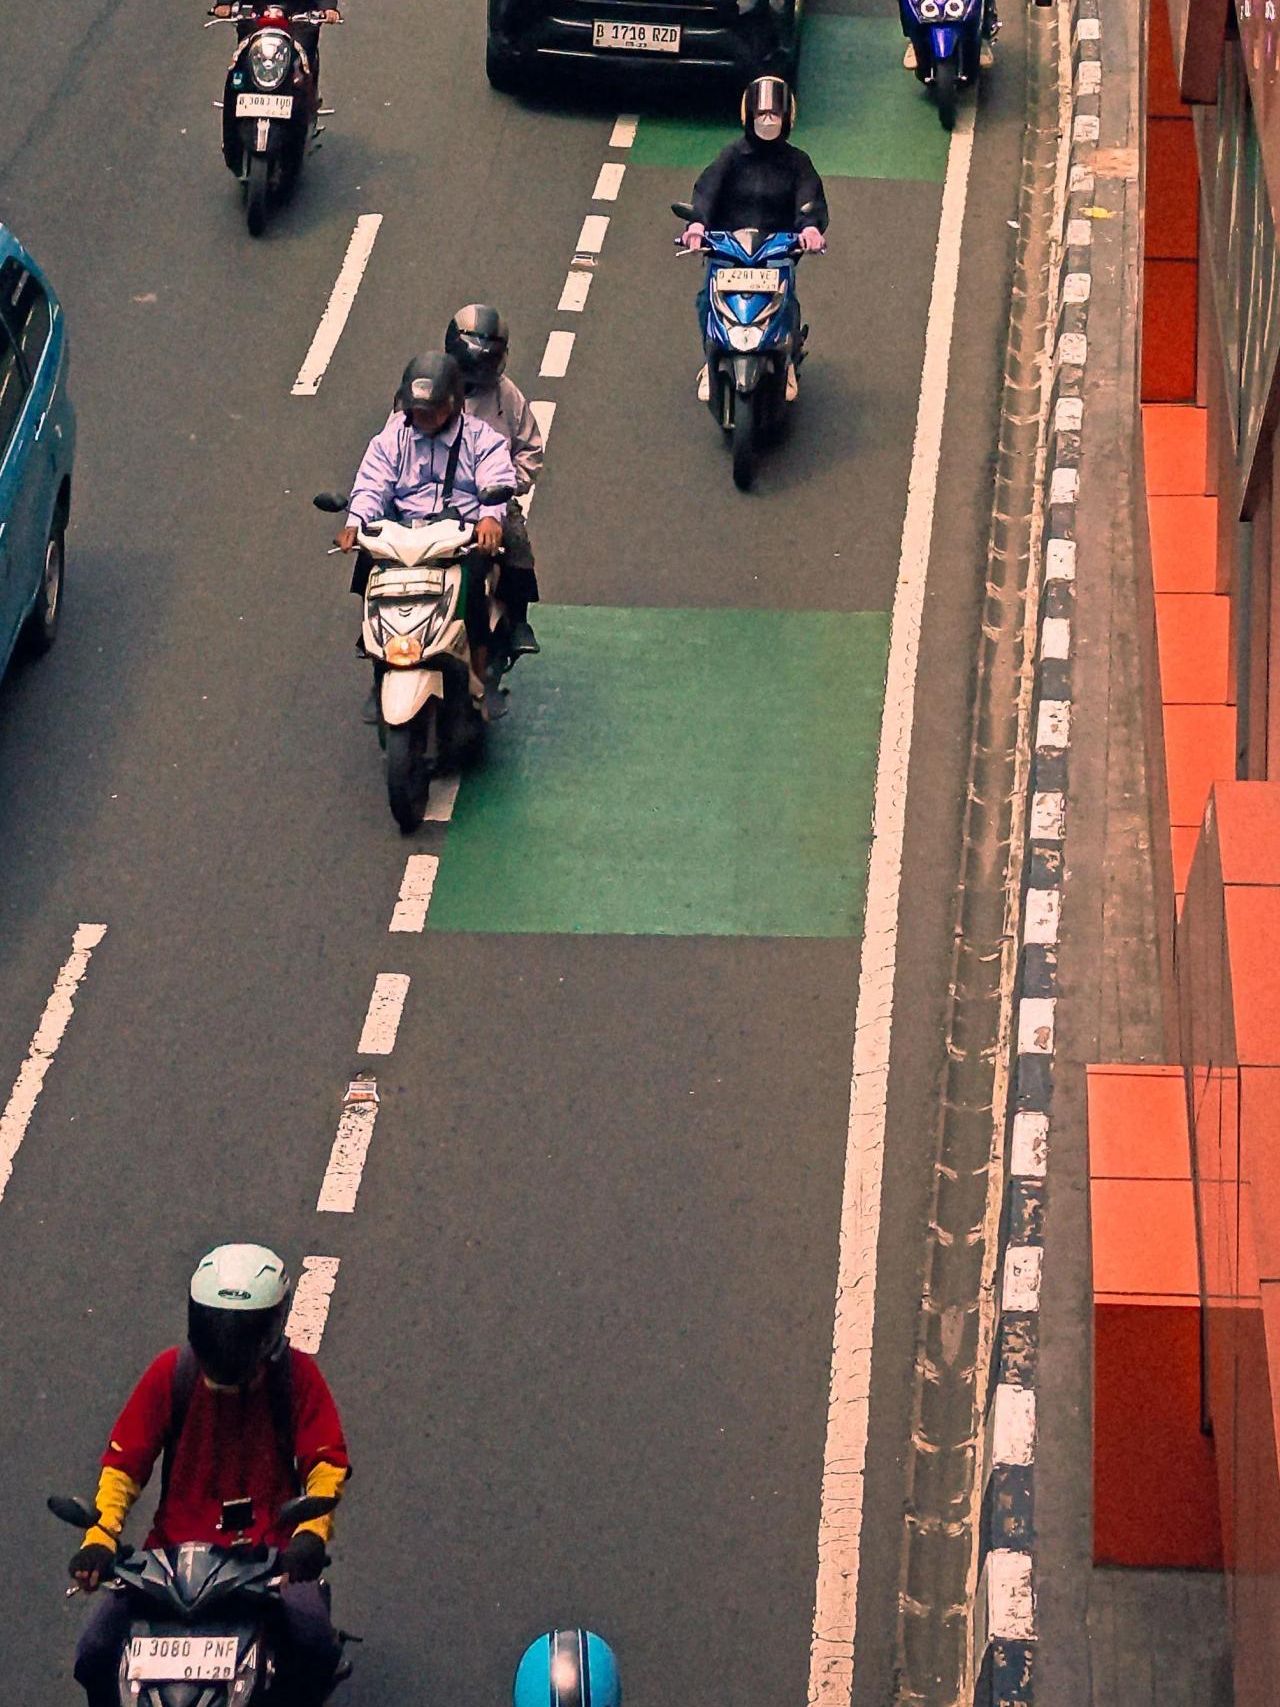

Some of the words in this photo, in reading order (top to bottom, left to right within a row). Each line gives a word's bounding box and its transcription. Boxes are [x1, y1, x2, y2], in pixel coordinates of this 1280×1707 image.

[596, 24, 604, 38] B
[611, 25, 646, 41] 1718
[652, 27, 678, 43] RZD
[204, 1640, 235, 1658] PNF
